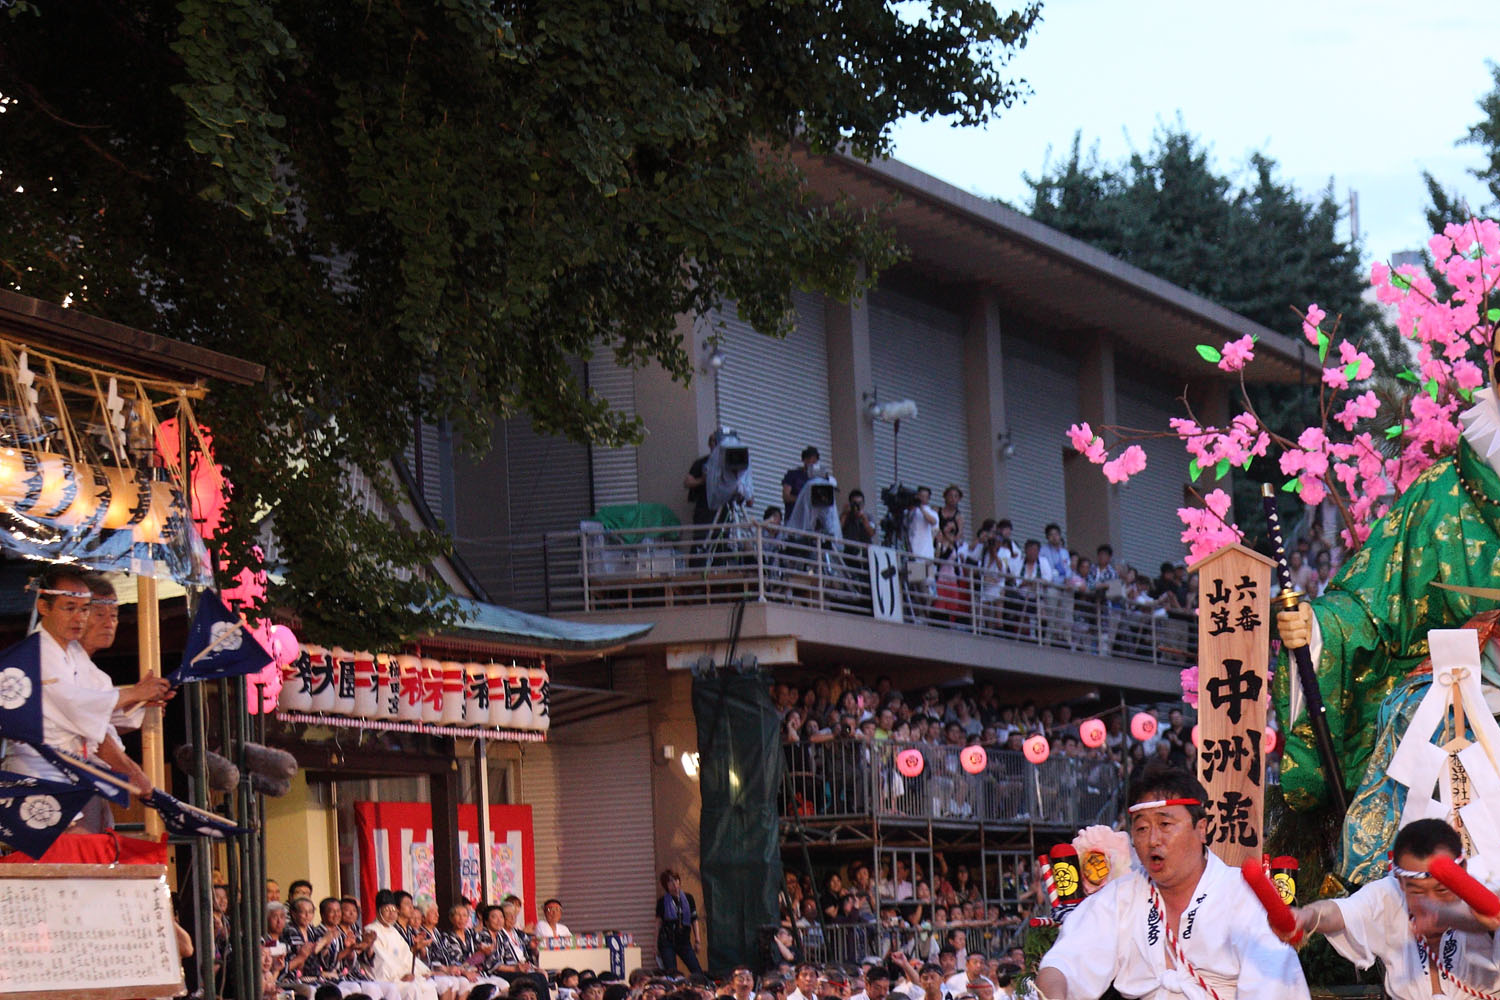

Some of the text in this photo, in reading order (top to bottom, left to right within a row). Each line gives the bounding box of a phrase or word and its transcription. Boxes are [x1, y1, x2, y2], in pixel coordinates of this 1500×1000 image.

[1206, 579, 1236, 637] 山笠
[1234, 575, 1262, 633] 六番
[1201, 658, 1263, 848] 中洲流
[459, 858, 479, 876] BC
